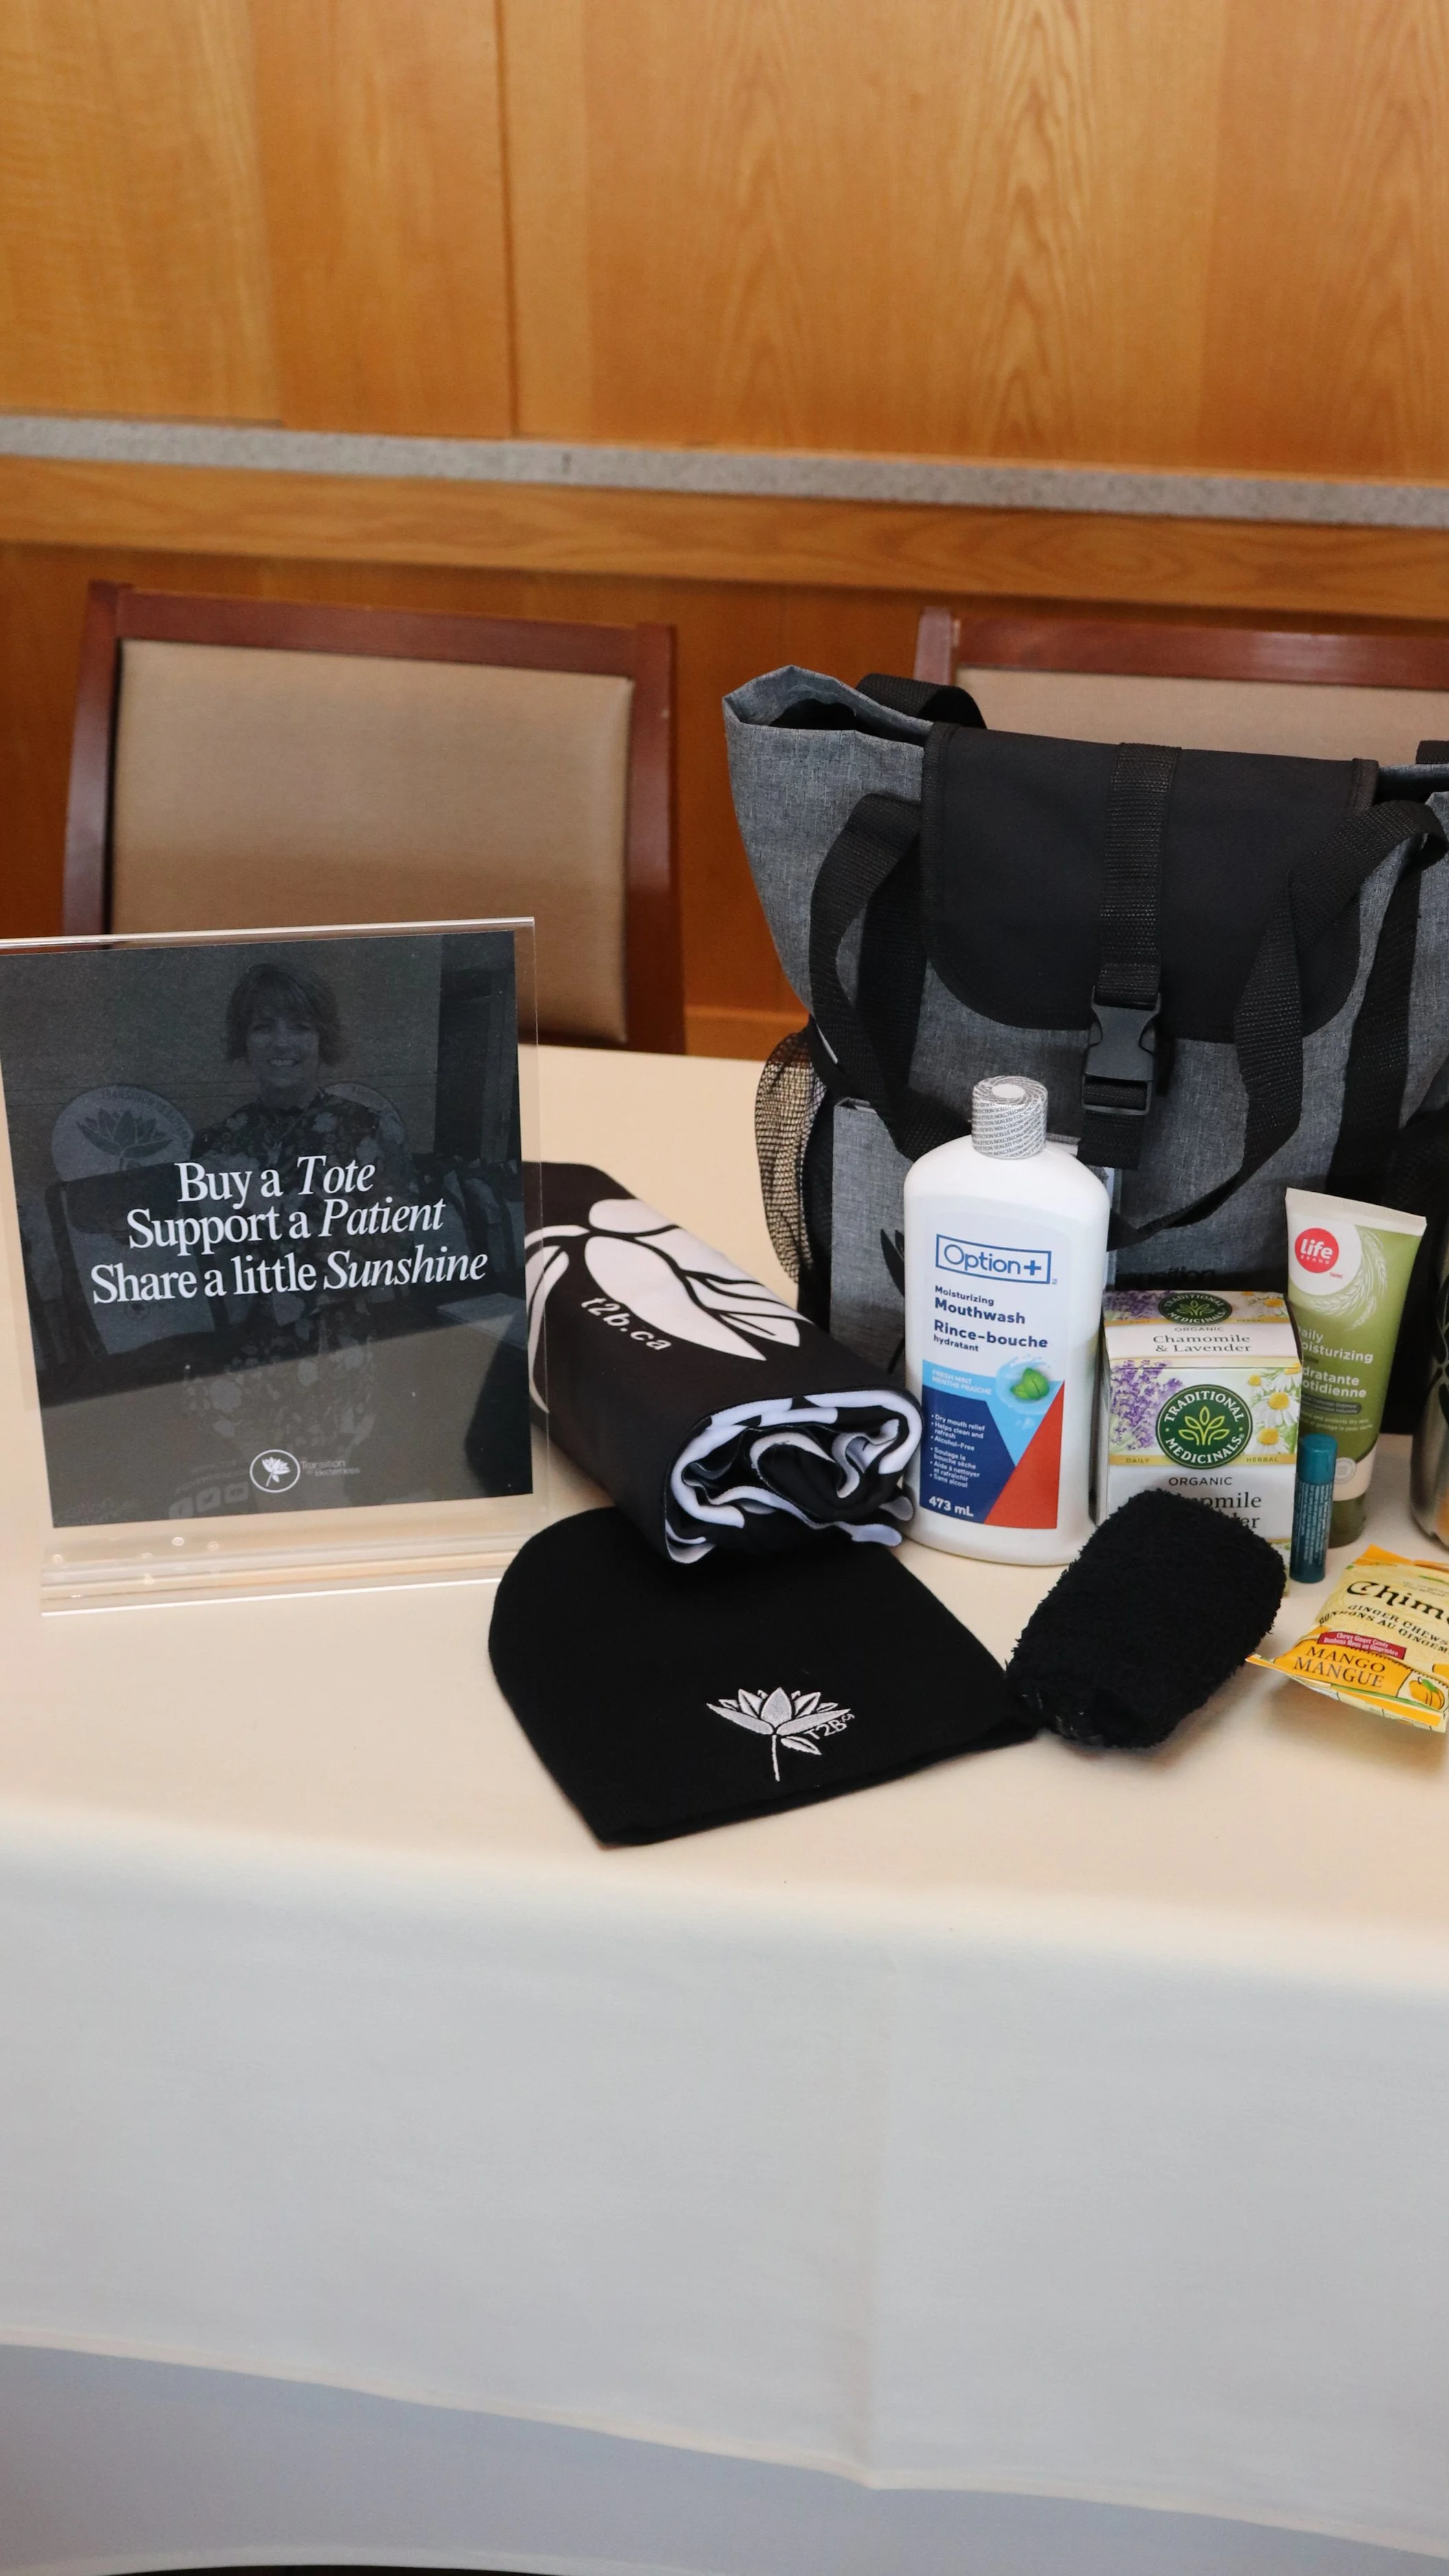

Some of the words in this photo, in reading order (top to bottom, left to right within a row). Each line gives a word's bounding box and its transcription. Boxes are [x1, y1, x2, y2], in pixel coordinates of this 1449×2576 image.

[175, 1162, 252, 1210] Buy
[260, 1169, 284, 1197] a
[297, 1155, 376, 1195] Tote
[126, 1206, 282, 1256] Support
[289, 1211, 311, 1239] a
[318, 1197, 446, 1236] Patient
[1301, 1238, 1333, 1260] life
[944, 1244, 1042, 1276] Option+
[90, 1263, 197, 1304] Share
[204, 1269, 227, 1297] a
[231, 1252, 317, 1295] little
[324, 1244, 488, 1290] Sunshine
[935, 1285, 994, 1306] Moisturizing
[935, 1297, 1025, 1324] Mouthwash
[581, 1298, 671, 1351] t2b.ca
[934, 1319, 1048, 1348] Rince-bouche
[934, 1334, 979, 1352] hydratant
[1153, 1335, 1251, 1344] Chamomile
[1299, 1329, 1324, 1344] aily
[1156, 1344, 1168, 1353] &
[1173, 1344, 1252, 1353] Lavender
[1301, 1342, 1373, 1364] oisturizing
[1302, 1366, 1360, 1386] dratante
[1302, 1379, 1367, 1398] otidienne
[1163, 1390, 1245, 1423] TRADITIONAL
[934, 1414, 945, 1423] Dry
[947, 1418, 967, 1428] mouth
[968, 1423, 985, 1432] relief
[934, 1421, 952, 1433] Helps
[953, 1427, 970, 1436] clean
[971, 1431, 984, 1439] and
[934, 1429, 956, 1439] refresh
[934, 1435, 975, 1451] Alcohol-Free
[934, 1447, 959, 1460] Soulage
[934, 1453, 956, 1465] bouche
[934, 1460, 947, 1470] Aide
[953, 1467, 980, 1478] nettoyer
[933, 1473, 948, 1483] Sans
[949, 1478, 968, 1488] alcool
[1168, 1476, 1233, 1487] ORGANIC
[928, 1495, 952, 1511] 473
[954, 1505, 974, 1517] mL
[1199, 1491, 1262, 1509] omile
[1347, 1581, 1449, 1626] Chim
[1348, 1604, 1400, 1623] GINGER
[1336, 1632, 1354, 1640] Chewy
[1354, 1636, 1372, 1645] Ginger
[1372, 1639, 1389, 1649] Candy
[1378, 1618, 1396, 1629] AU
[1398, 1628, 1449, 1654] GINGEM
[1305, 1647, 1386, 1673] MANGO
[1293, 1656, 1386, 1688] MANGUE
